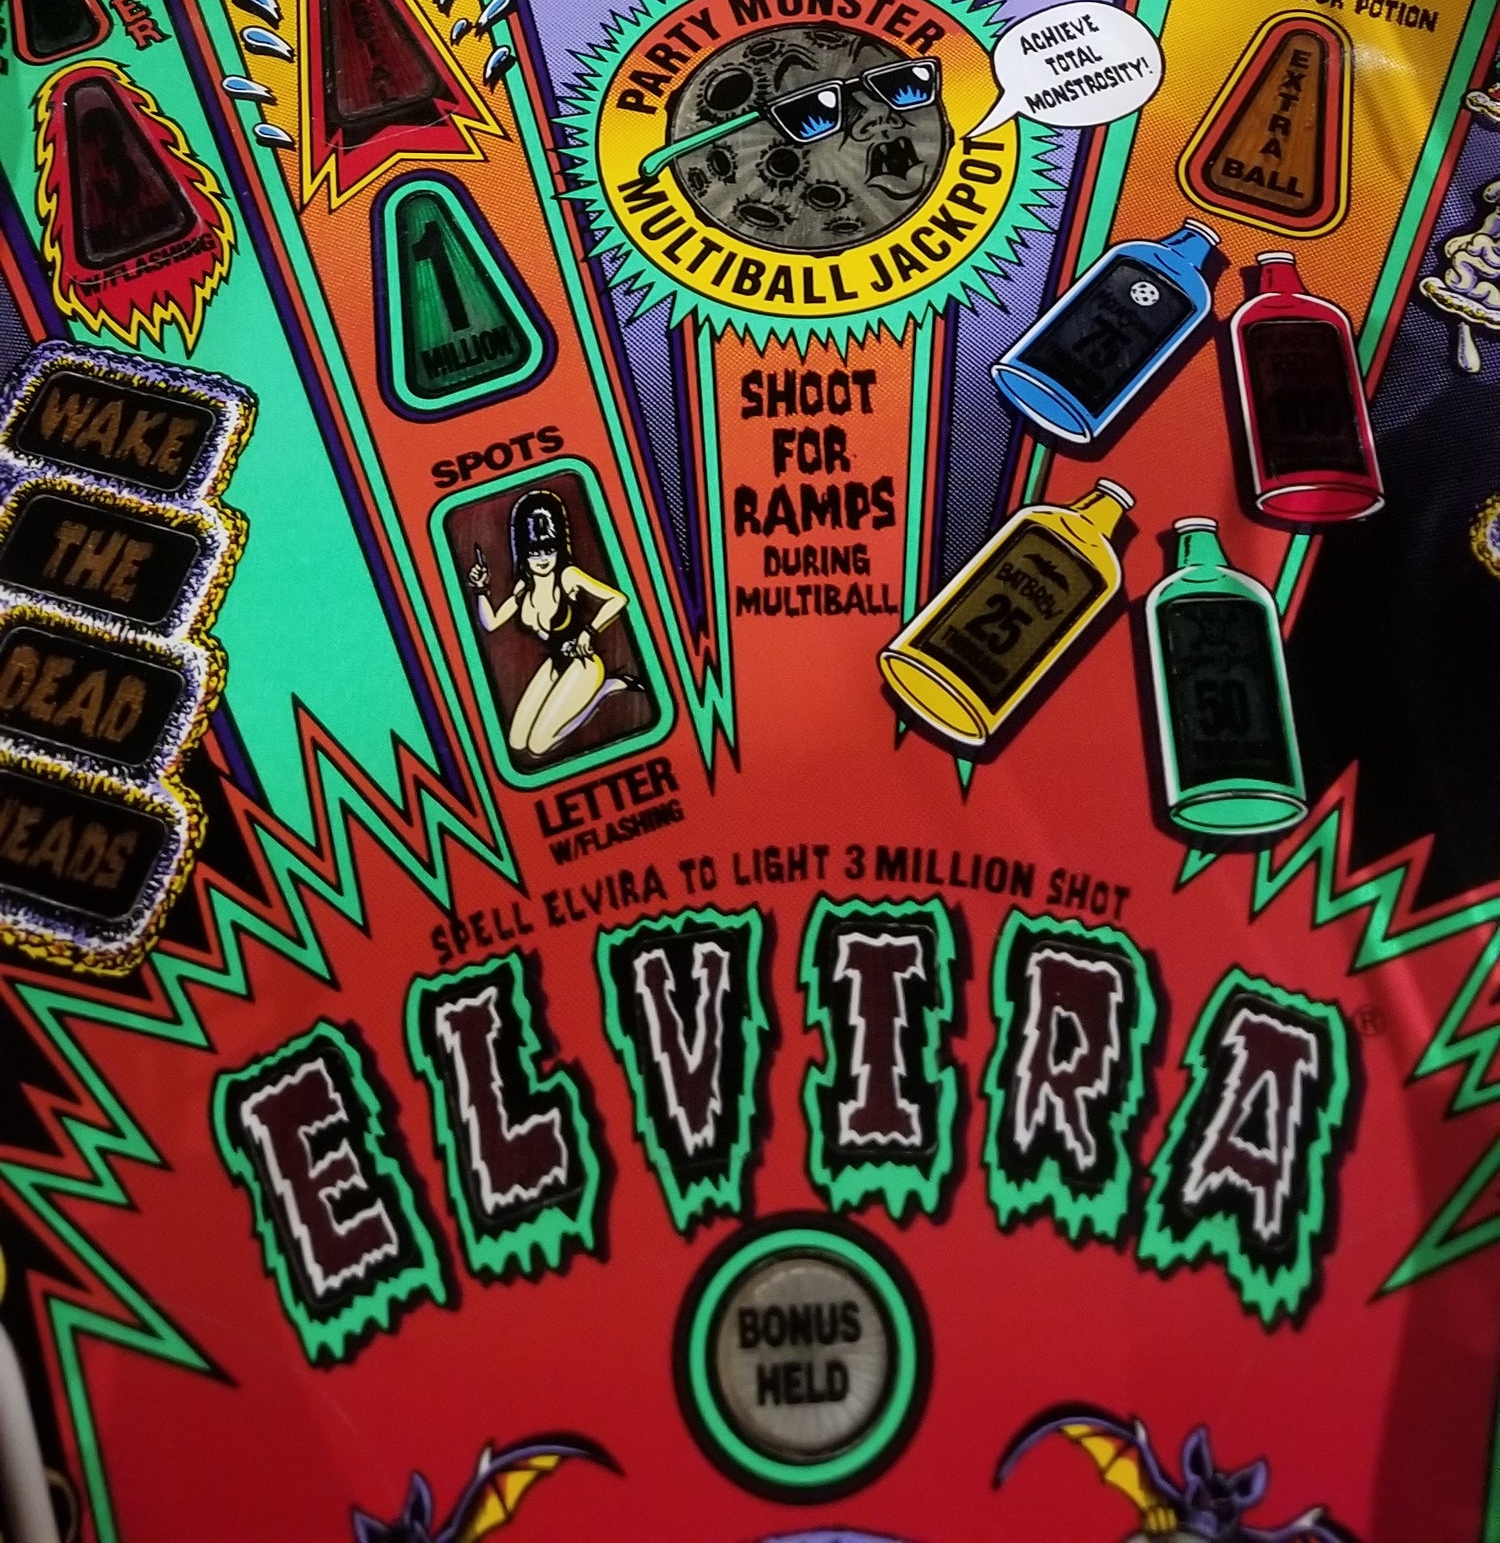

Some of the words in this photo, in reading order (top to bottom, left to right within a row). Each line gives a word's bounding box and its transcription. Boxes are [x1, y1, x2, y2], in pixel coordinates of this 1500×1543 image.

[616, 7, 722, 116] PARTY
[1020, 13, 1100, 56] ACHIEVE
[1045, 46, 1104, 77] TOTAL
[1024, 57, 1154, 114] MONSTROSITY!
[1261, 49, 1312, 158] EXTRA
[1221, 157, 1304, 199] BALL
[618, 176, 859, 304] MULTIBALL
[869, 136, 1006, 293] JACKPOT
[80, 231, 218, 298] W/FLASHING
[411, 220, 470, 331] 1
[422, 326, 513, 379] MILLION
[741, 368, 877, 420] SHOOT
[41, 388, 199, 475] WAKE
[431, 425, 566, 489] SPOTS
[773, 424, 851, 477] FOR
[734, 475, 897, 537] RAMPS
[54, 520, 154, 603] THE
[764, 543, 871, 577] DURING
[736, 582, 900, 617] MULTIBALL
[966, 594, 1033, 654] 25
[0, 645, 146, 743] DEAD
[534, 757, 680, 838] LETTER
[549, 799, 685, 866] W/FLASHING
[430, 903, 534, 966] SPELL
[544, 861, 669, 930] ELVIRA
[678, 860, 721, 893] TO
[731, 844, 831, 887] LIGHT
[842, 846, 867, 881] 3
[874, 844, 1034, 899] MILLION
[1045, 867, 1130, 921] SHOT
[240, 930, 1323, 1300] ELVIRA
[736, 1305, 863, 1352] BONUS
[754, 1359, 853, 1409] HELD
